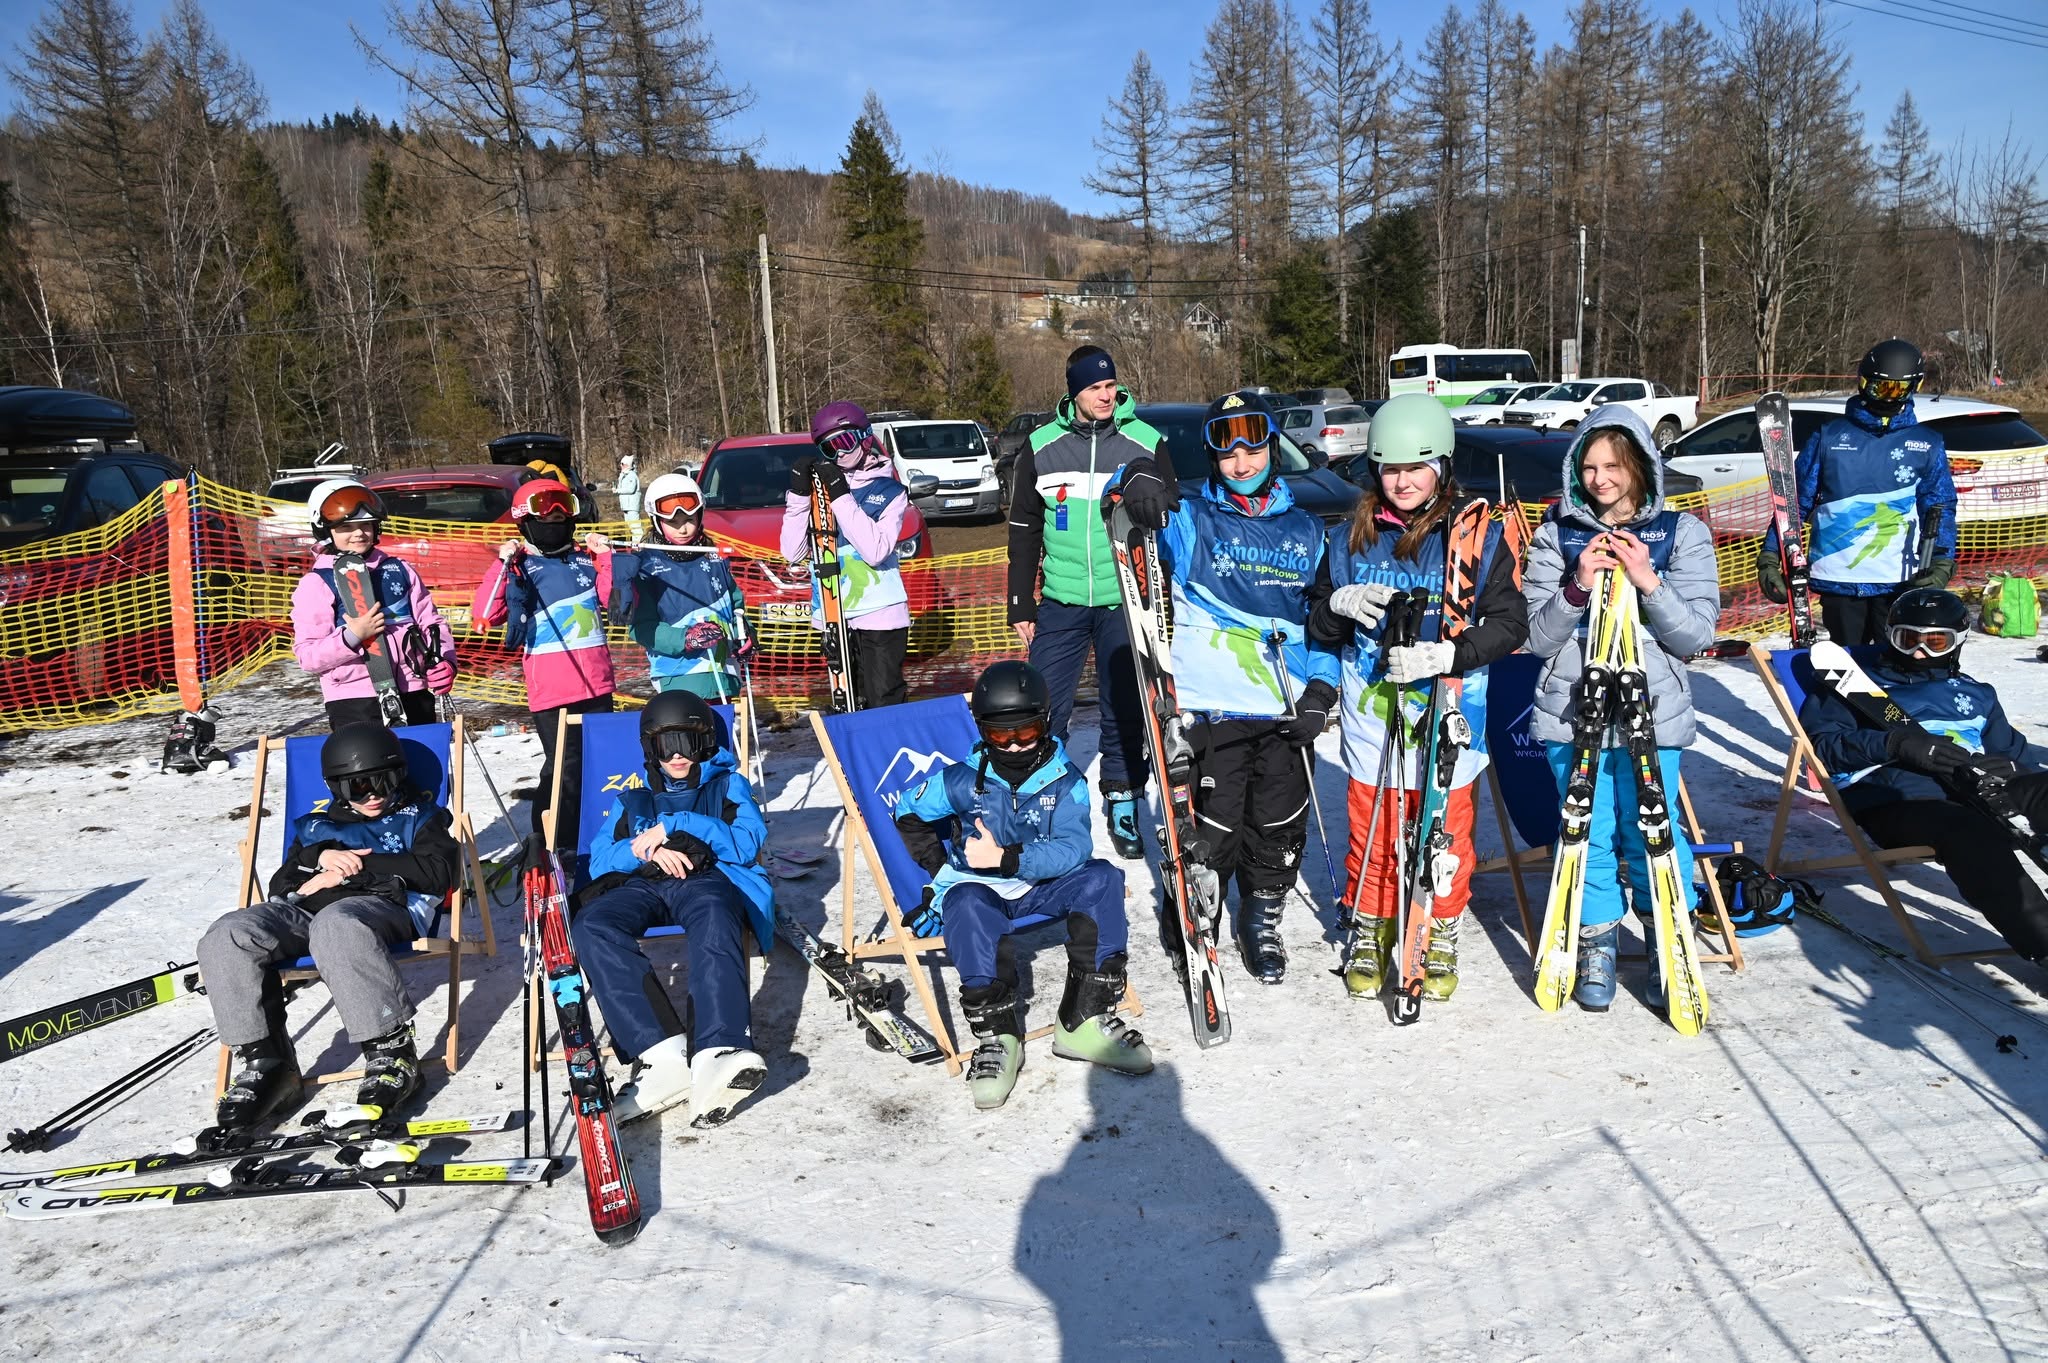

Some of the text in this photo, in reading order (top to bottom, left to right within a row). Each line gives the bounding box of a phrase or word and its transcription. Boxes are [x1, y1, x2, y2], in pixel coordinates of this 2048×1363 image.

[812, 471, 829, 546] RSSIGNOL
[1240, 563, 1252, 571] na
[794, 603, 811, 617] 80
[41, 1189, 174, 1210] HEAD
